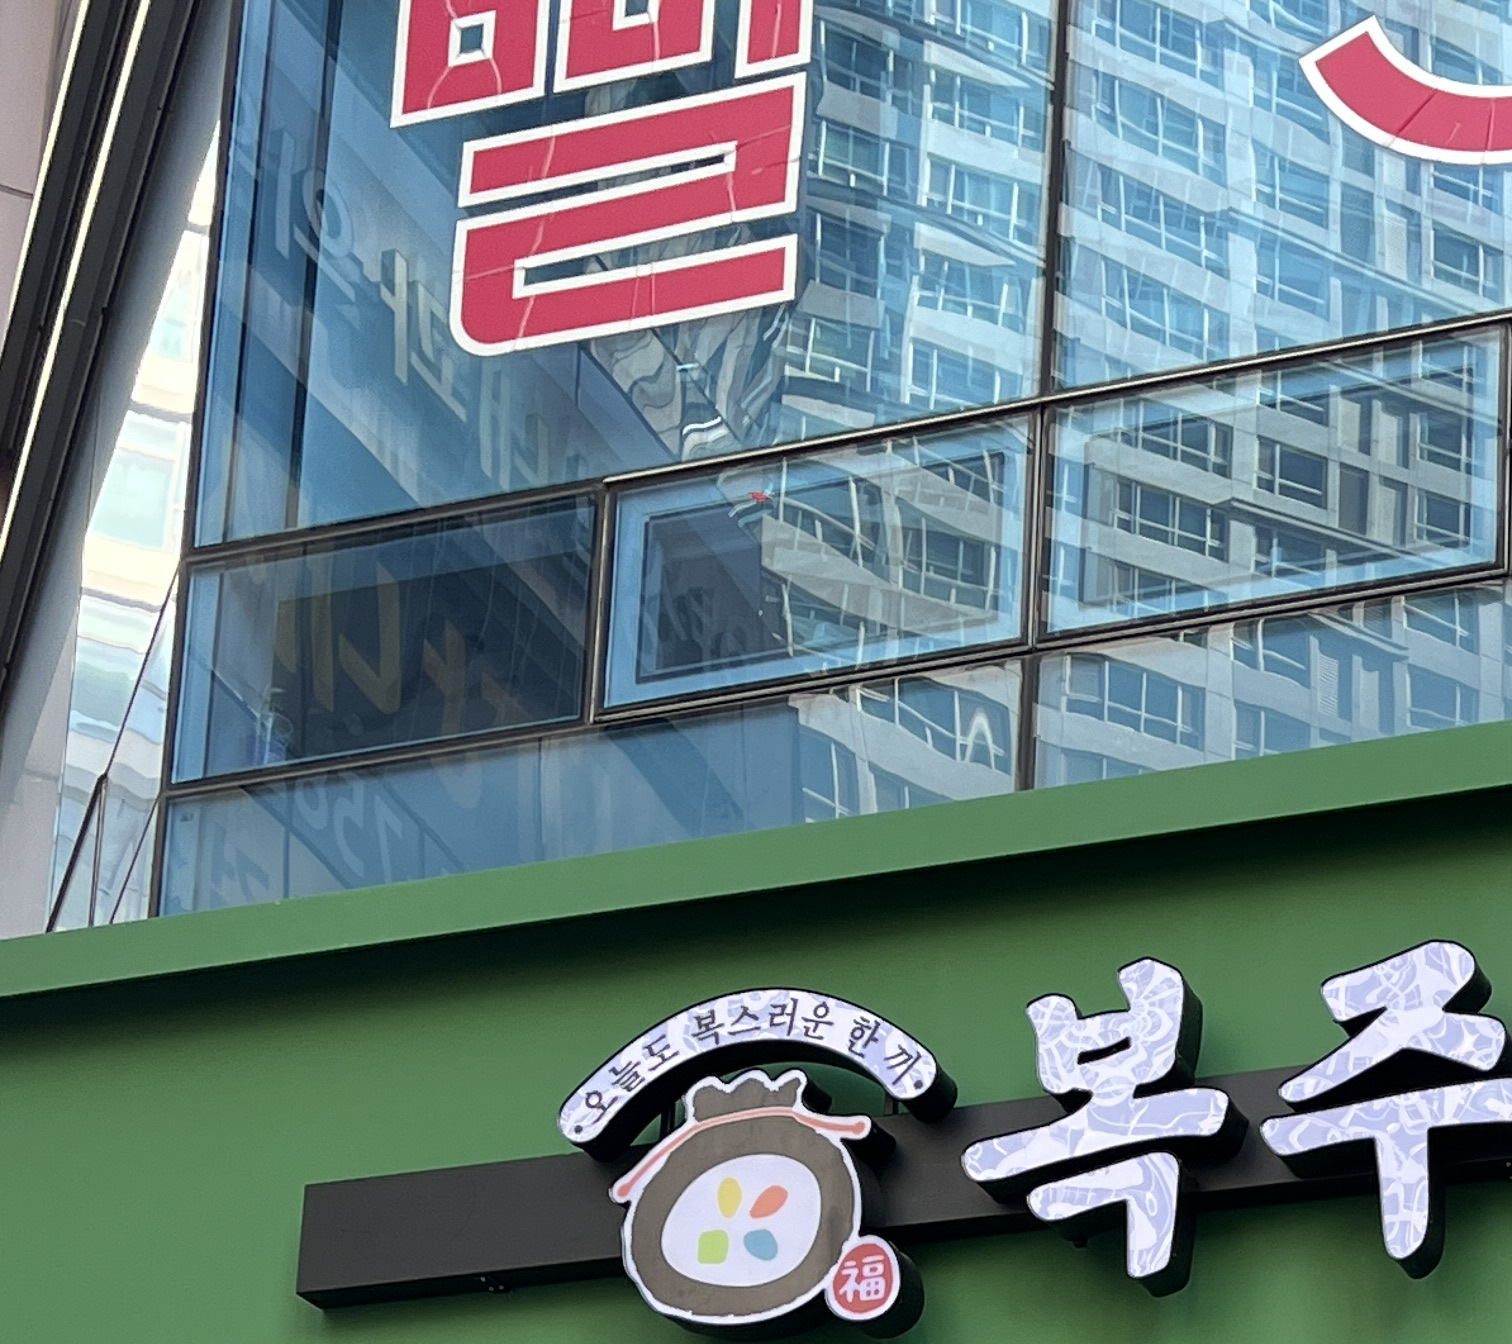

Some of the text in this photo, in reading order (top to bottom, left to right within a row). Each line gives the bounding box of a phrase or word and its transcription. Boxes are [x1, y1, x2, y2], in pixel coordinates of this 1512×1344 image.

[584, 997, 924, 1123] 오늘도 복스러운 한 끼
[839, 1254, 887, 1303] 福
